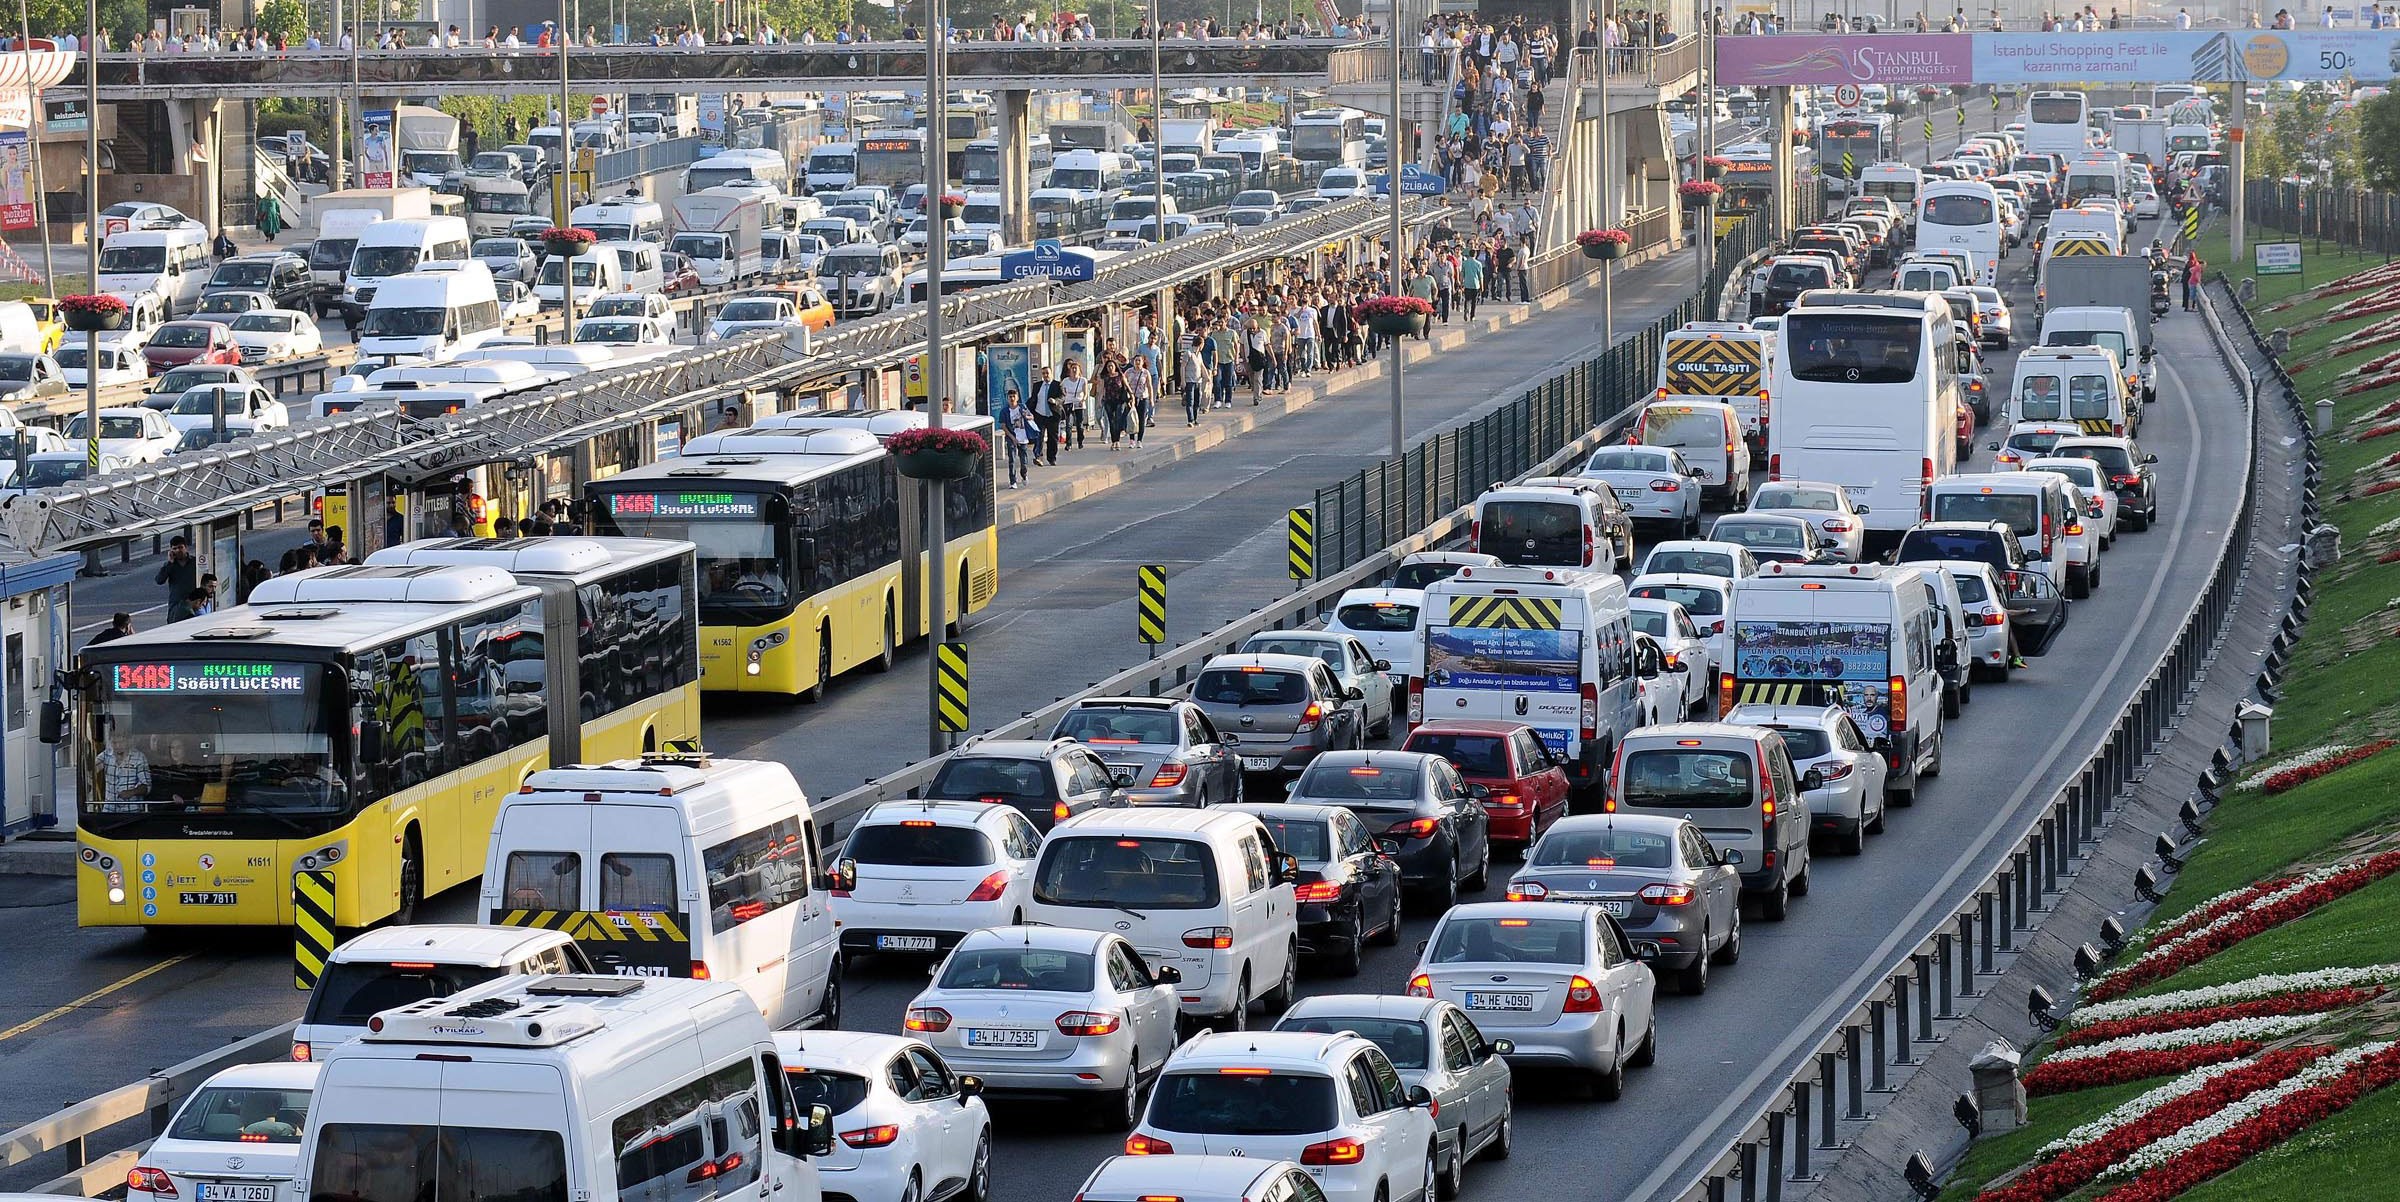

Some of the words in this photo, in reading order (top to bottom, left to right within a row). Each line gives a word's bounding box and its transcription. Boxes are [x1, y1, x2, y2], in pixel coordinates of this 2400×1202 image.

[1993, 41, 2045, 57] İstanbul
[2050, 43, 2113, 59] Shopping
[2118, 43, 2147, 56] Fest
[2152, 42, 2167, 55] ile
[2023, 60, 2082, 72] kazanma
[2086, 59, 2137, 72] zamanı!
[1386, 180, 1436, 191] CİZLİBAĞ
[1014, 263, 1081, 277] CEVİZLİBAĞ
[1678, 362, 1709, 372] OKUL
[1714, 364, 1750, 374] TAŞITI
[616, 494, 654, 512] 34AS
[118, 664, 170, 689] 34AS
[1250, 758, 1268, 766] 1875
[248, 858, 270, 866] K1611
[183, 894, 194, 903] 34
[198, 894, 208, 903] TP
[212, 894, 234, 903] 7811
[884, 936, 894, 946] 34
[898, 937, 908, 947] TY
[911, 938, 932, 948] 7771
[1474, 994, 1485, 1005] 34
[1488, 994, 1500, 1006] HE
[1505, 995, 1530, 1006] 4090
[976, 1030, 988, 1042] 34
[992, 1031, 1005, 1042] HJ
[1010, 1032, 1034, 1042] 7535
[205, 1186, 218, 1199] 34
[223, 1186, 240, 1200] VA
[242, 1187, 269, 1200] 1260
